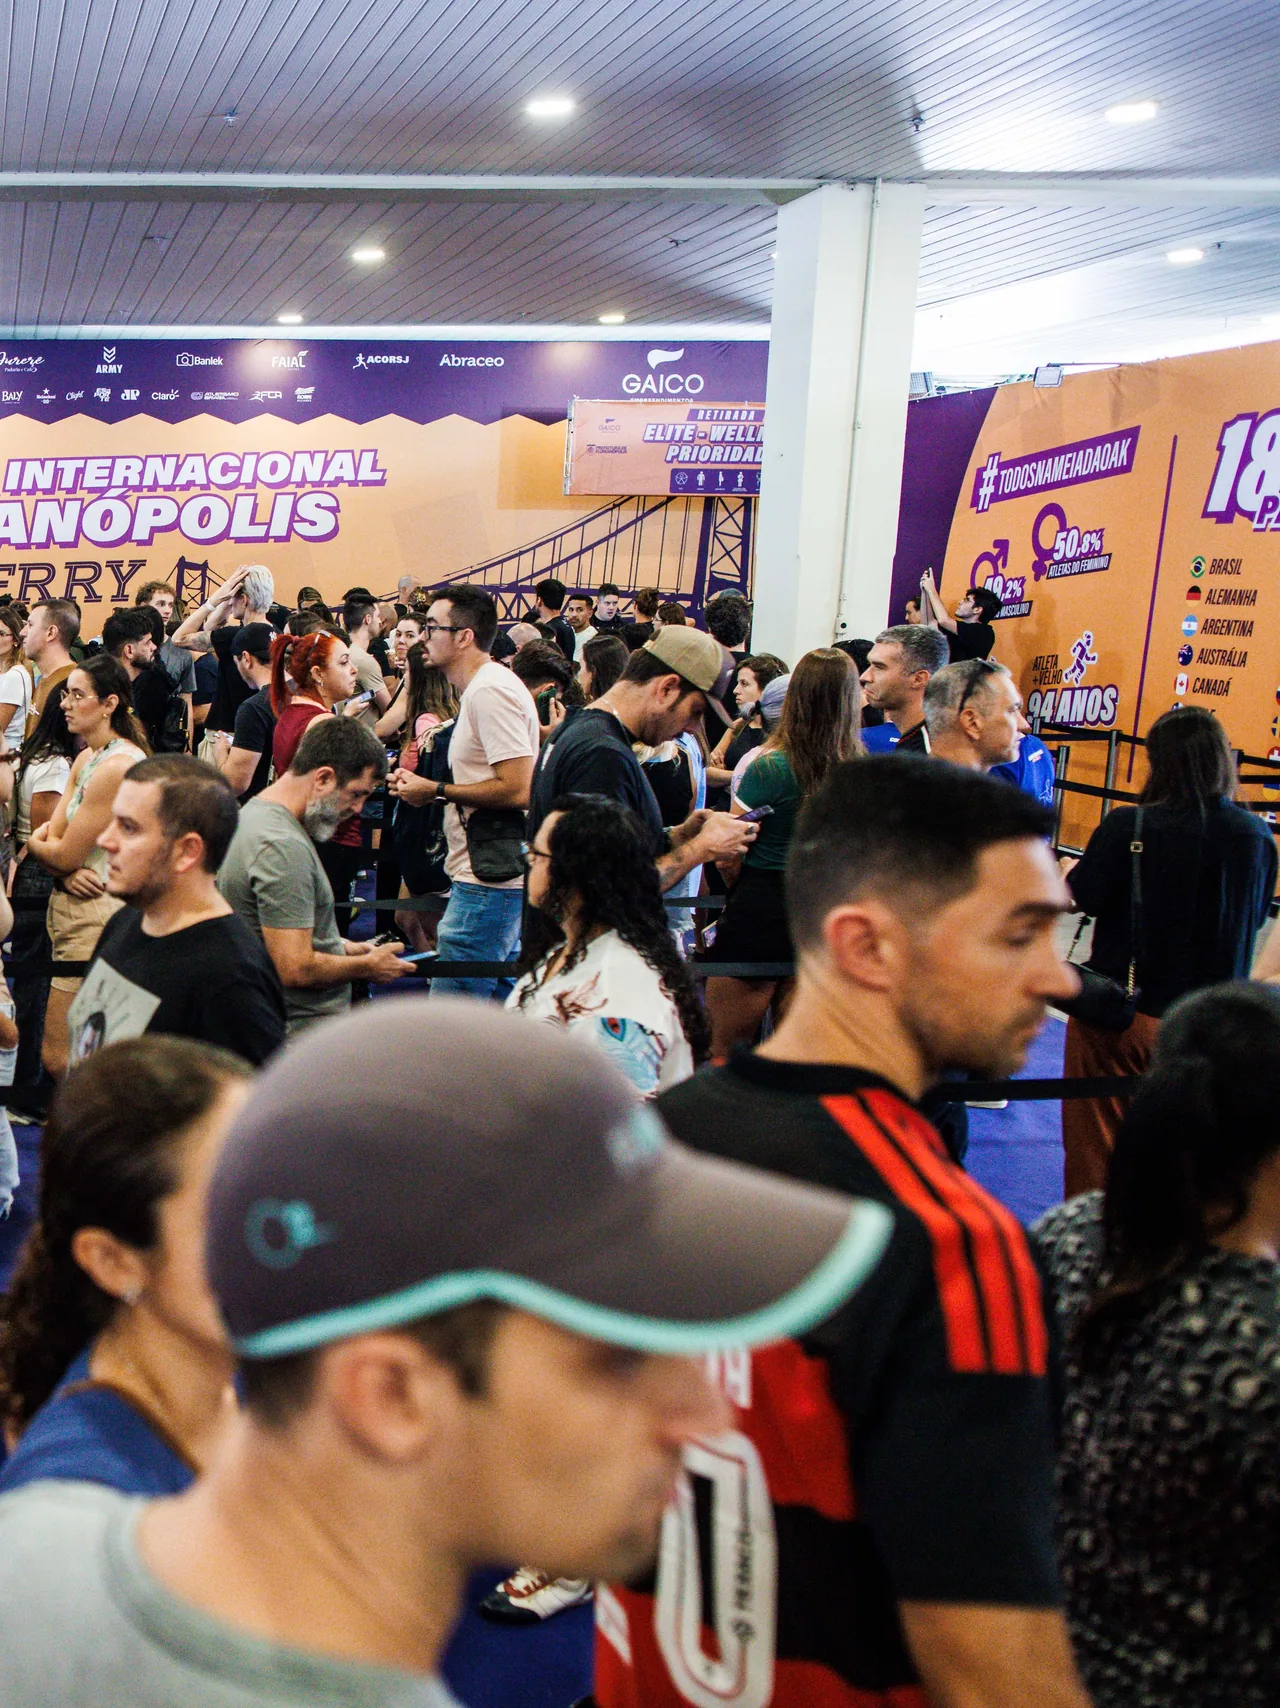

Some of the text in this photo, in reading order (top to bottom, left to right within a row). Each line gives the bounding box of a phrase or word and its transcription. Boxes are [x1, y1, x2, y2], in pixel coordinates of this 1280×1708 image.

[96, 364, 123, 373] ARMY
[194, 356, 223, 366] Banlek
[366, 355, 410, 364] ACORSJ
[439, 354, 505, 367] Abraceo
[622, 373, 704, 394] GAICO
[2, 391, 23, 401] BALY
[697, 409, 756, 421] RETIRADA
[643, 423, 698, 443] ELITE
[2, 449, 387, 495] INTERNACIONAL
[978, 437, 1132, 511] #TODOSNAMEIADAOAK
[1052, 528, 1103, 561] 50,8%
[1048, 555, 1109, 578] ATLETAS DO FEMININO
[1209, 558, 1243, 575] BRASIL
[1204, 588, 1258, 606] ALEMANHA
[1200, 618, 1254, 637] ARGENTINA
[1032, 654, 1059, 672] ATLETA
[1196, 647, 1249, 668] AUSTRÁLIA
[1192, 677, 1233, 697] CANADÁ
[1027, 685, 1118, 725] 94 ANOS
